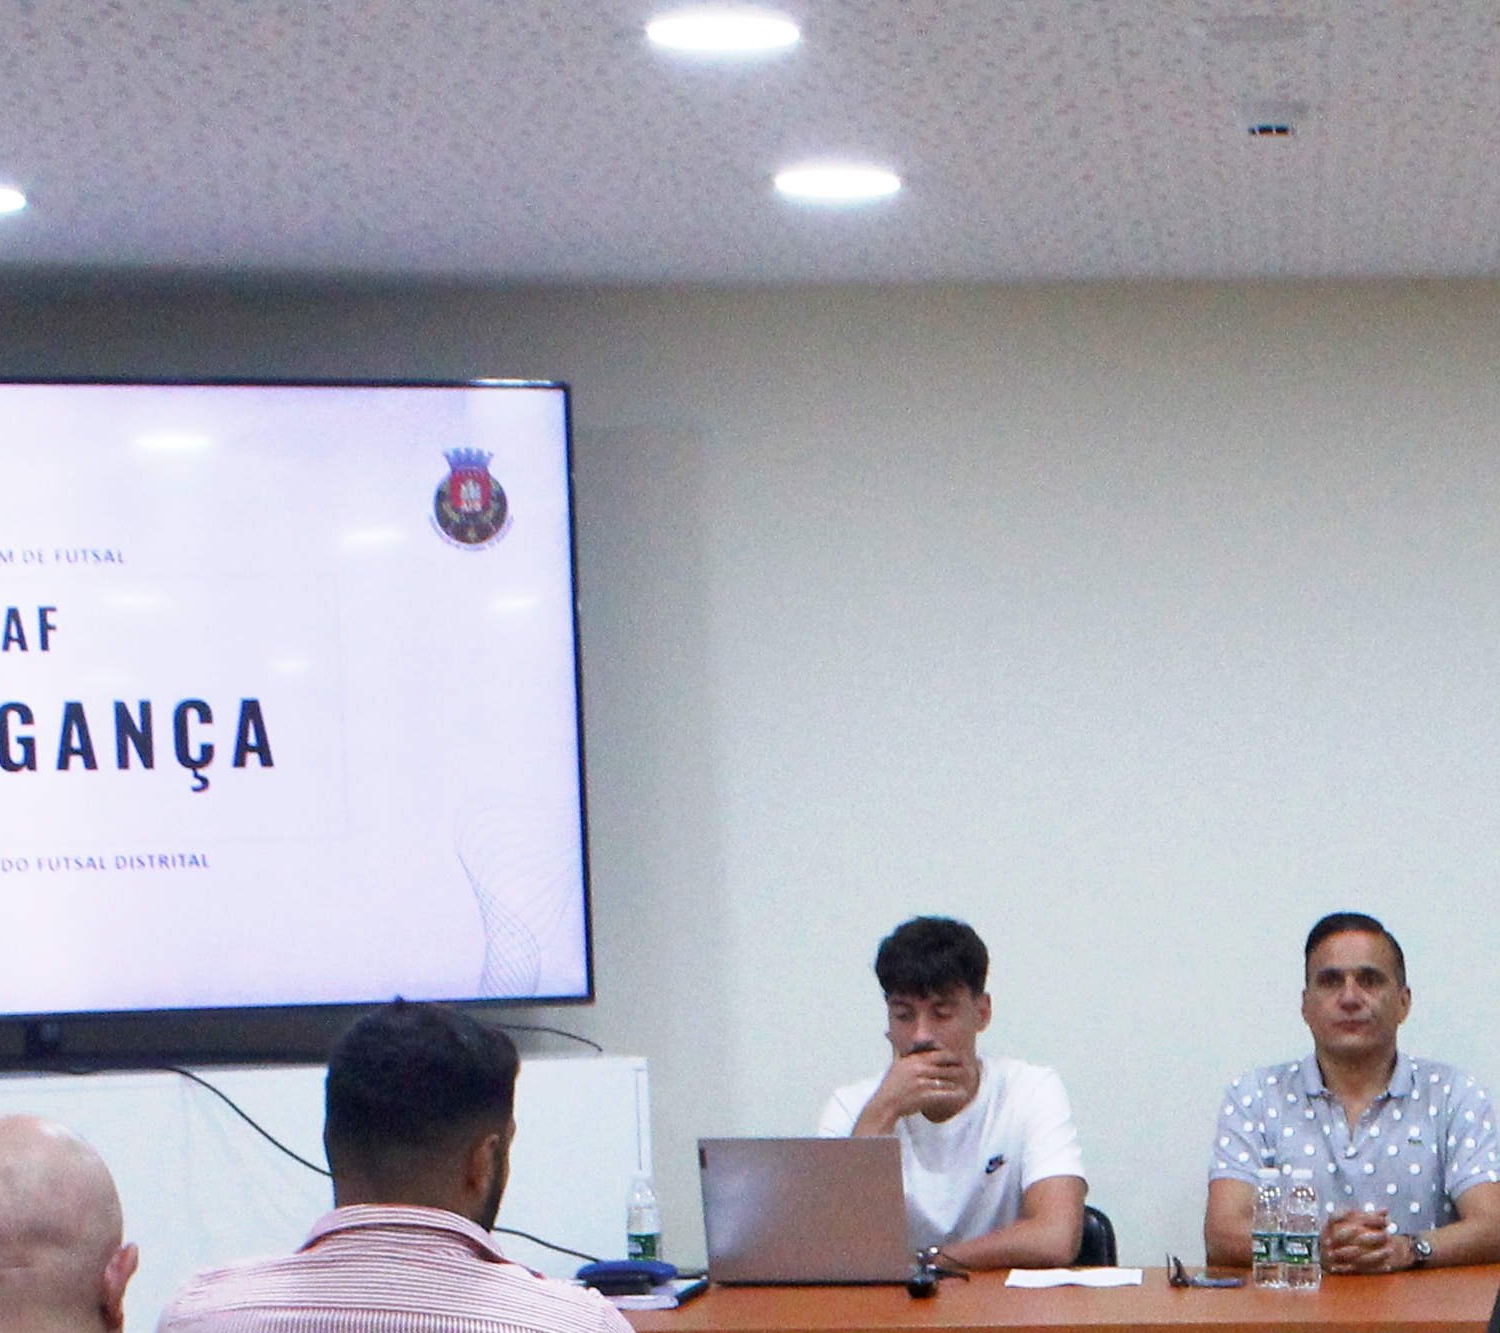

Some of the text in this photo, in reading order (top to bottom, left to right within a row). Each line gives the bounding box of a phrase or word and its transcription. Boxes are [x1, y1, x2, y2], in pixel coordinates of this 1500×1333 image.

[22, 548, 45, 564] DE
[54, 548, 125, 564] FUTSAL
[1, 605, 58, 652] AF
[1, 857, 30, 872] DO
[37, 854, 106, 871] FUTSAL
[115, 852, 212, 870] DISTRITAL
